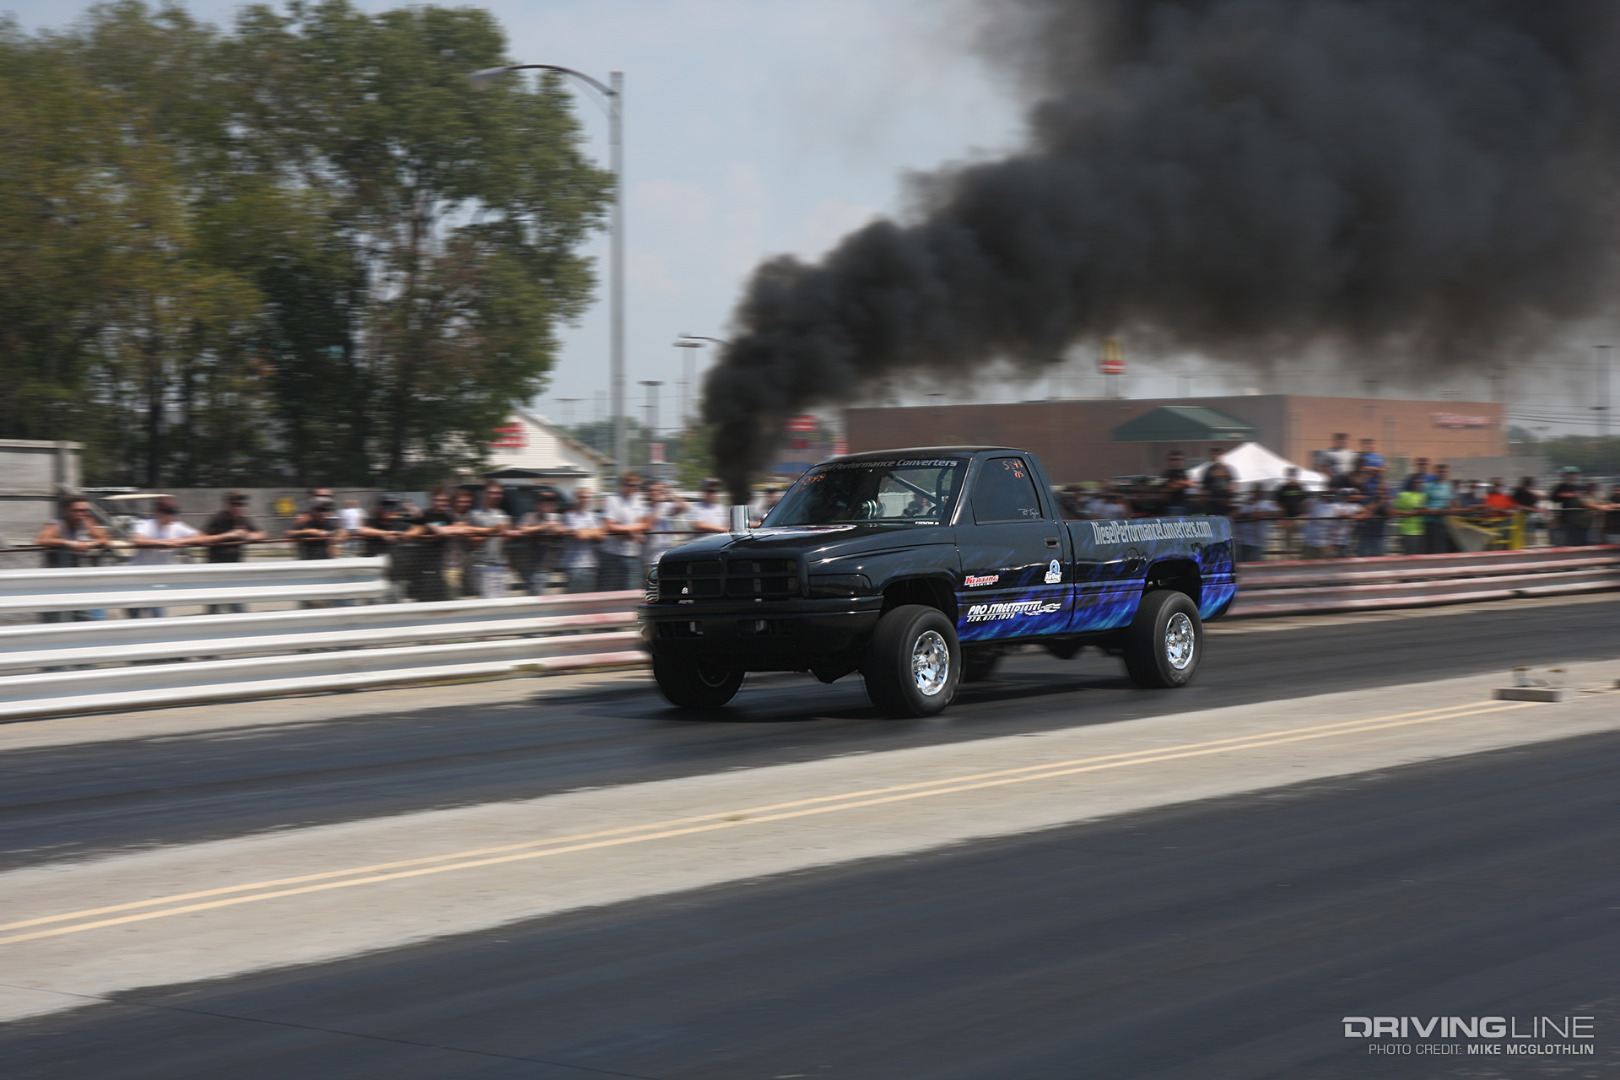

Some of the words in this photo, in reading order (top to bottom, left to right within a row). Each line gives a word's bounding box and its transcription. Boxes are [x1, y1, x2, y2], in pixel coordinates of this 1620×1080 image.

[896, 459, 959, 468] Converters
[1090, 519, 1214, 545] DieselPerformanceConverters.com
[967, 604, 988, 616] PRO
